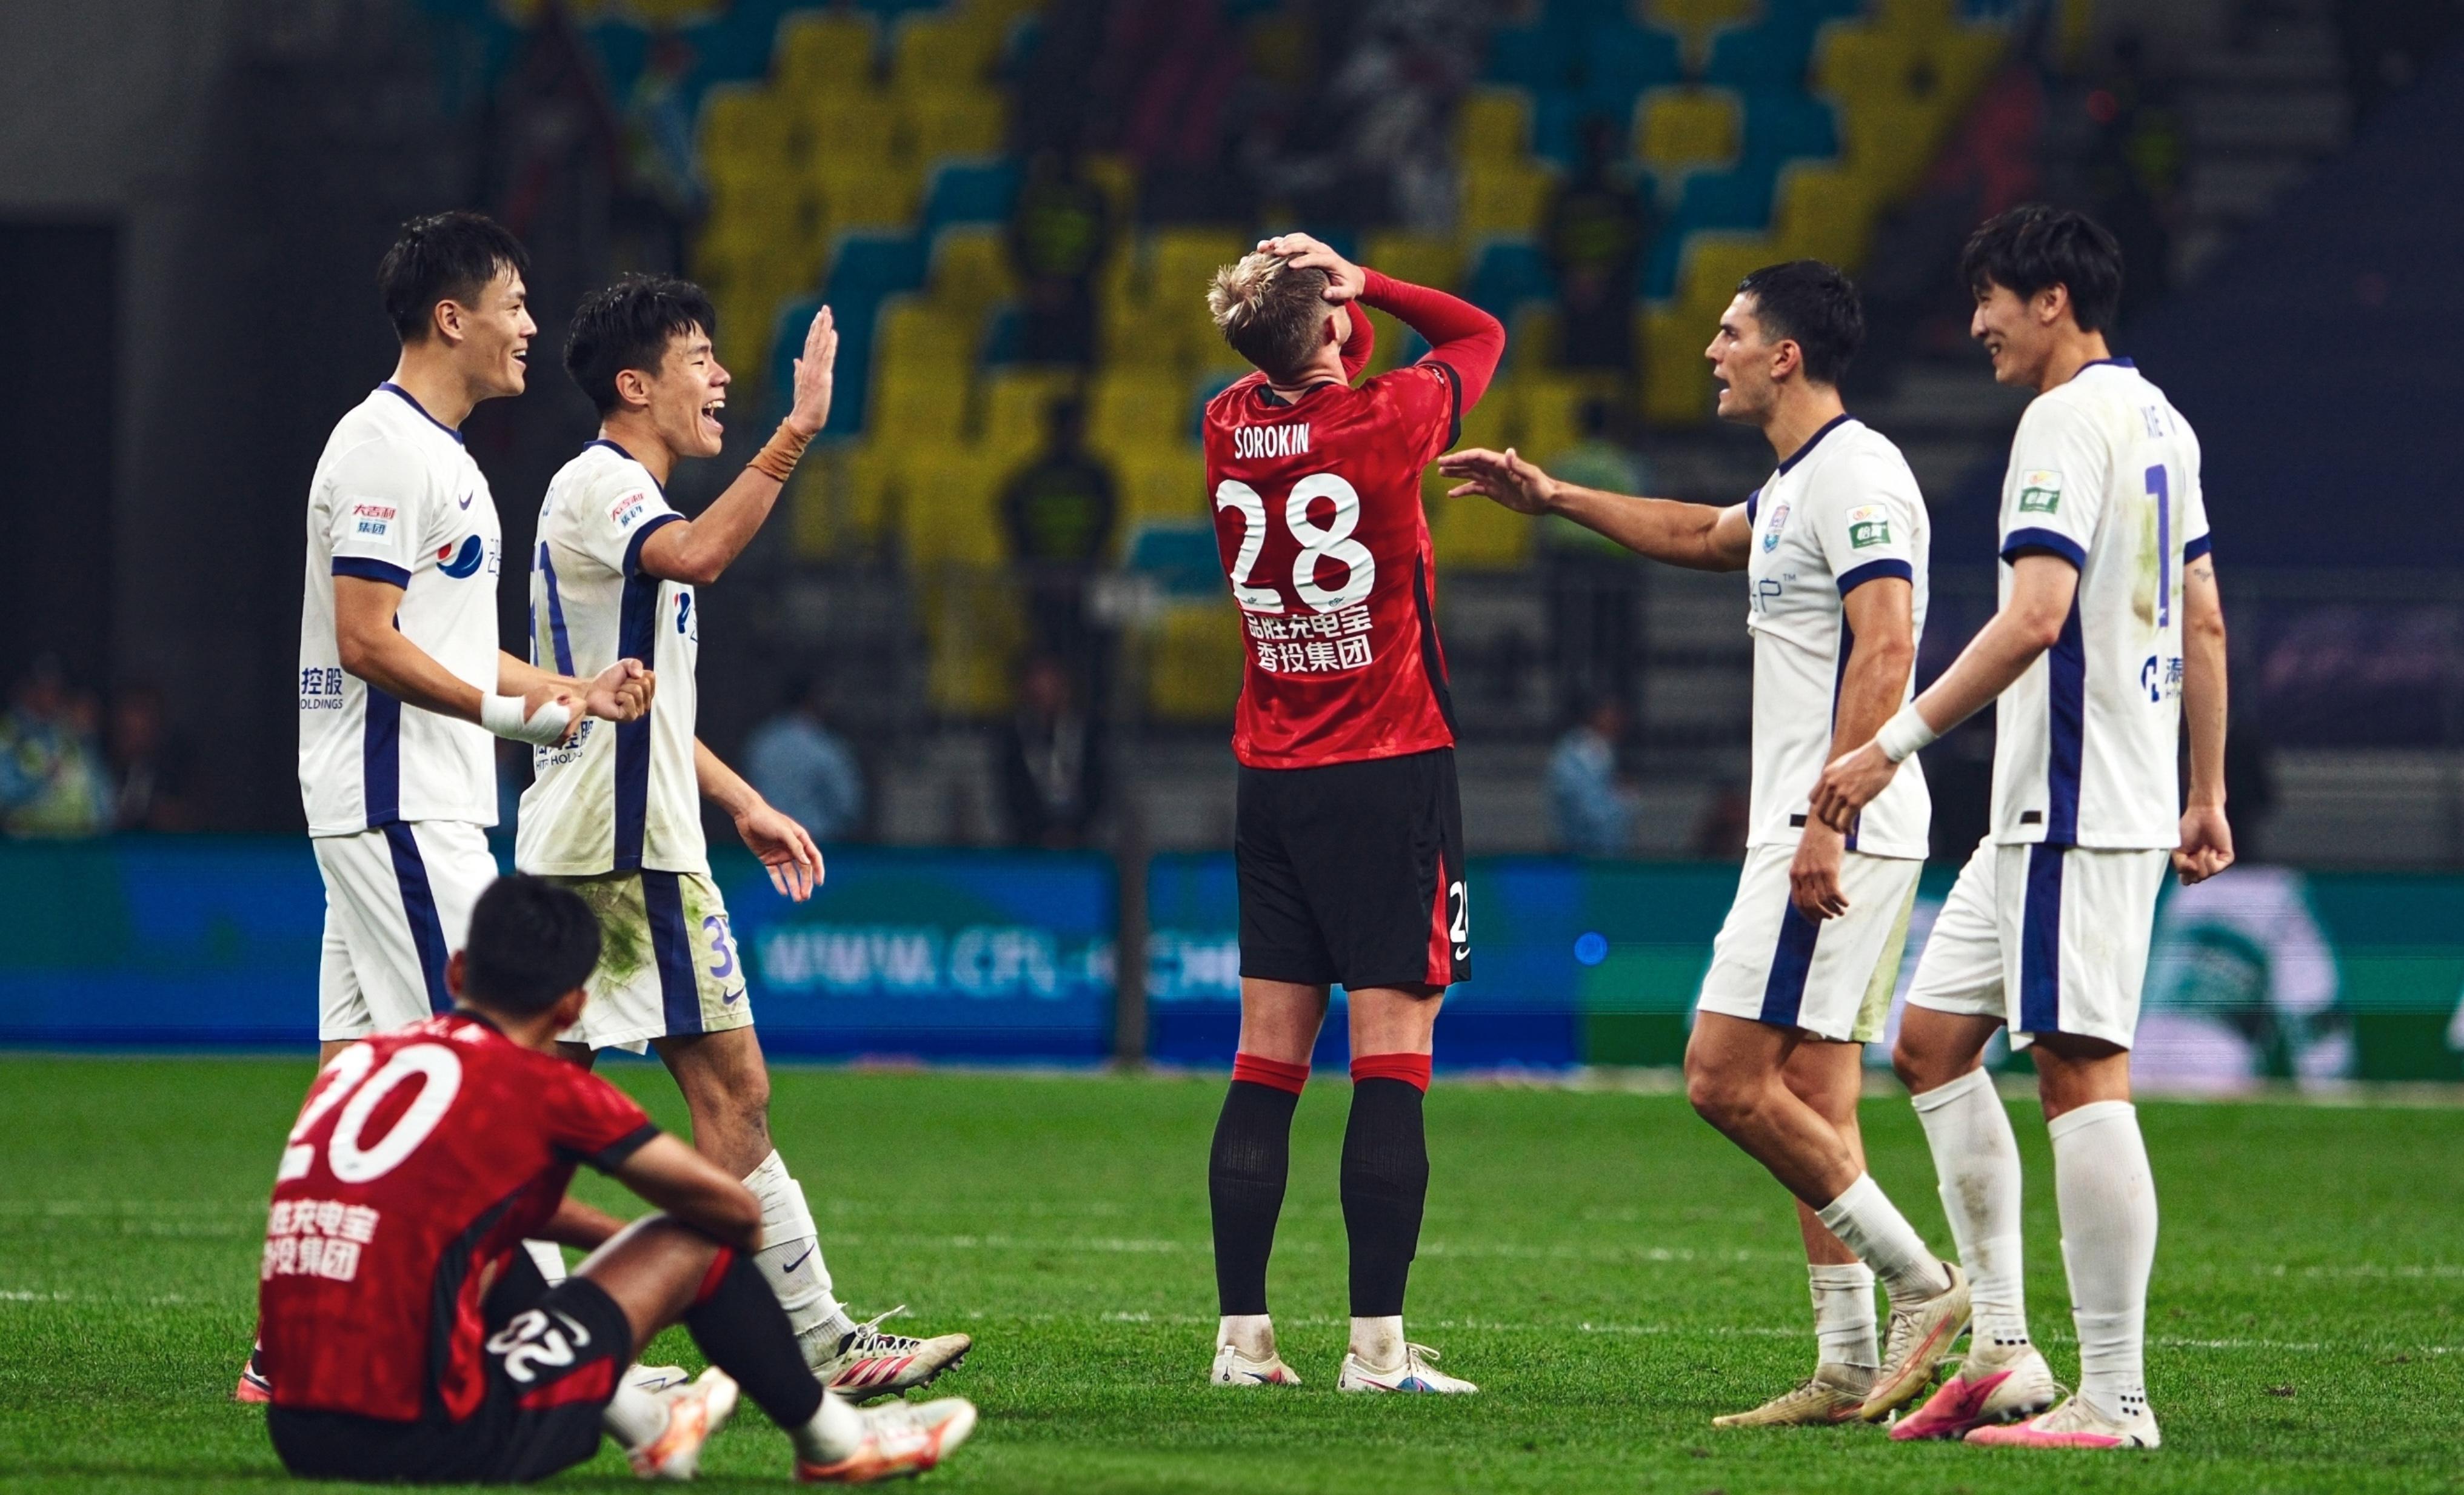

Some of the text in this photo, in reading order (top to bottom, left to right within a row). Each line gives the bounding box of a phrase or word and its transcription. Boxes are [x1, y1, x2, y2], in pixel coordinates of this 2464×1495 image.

[1234, 422, 1309, 459] SOROKIN
[353, 503, 396, 520] 大吉利
[1215, 472, 1375, 614] 28
[1244, 605, 1373, 640] 品胜充电宝
[1257, 634, 1373, 673] 香投集团
[301, 667, 342, 695] 控股
[1450, 881, 1469, 943] 2
[703, 915, 733, 978] 3
[278, 1042, 462, 1184] 20
[486, 1308, 575, 1383] 20
